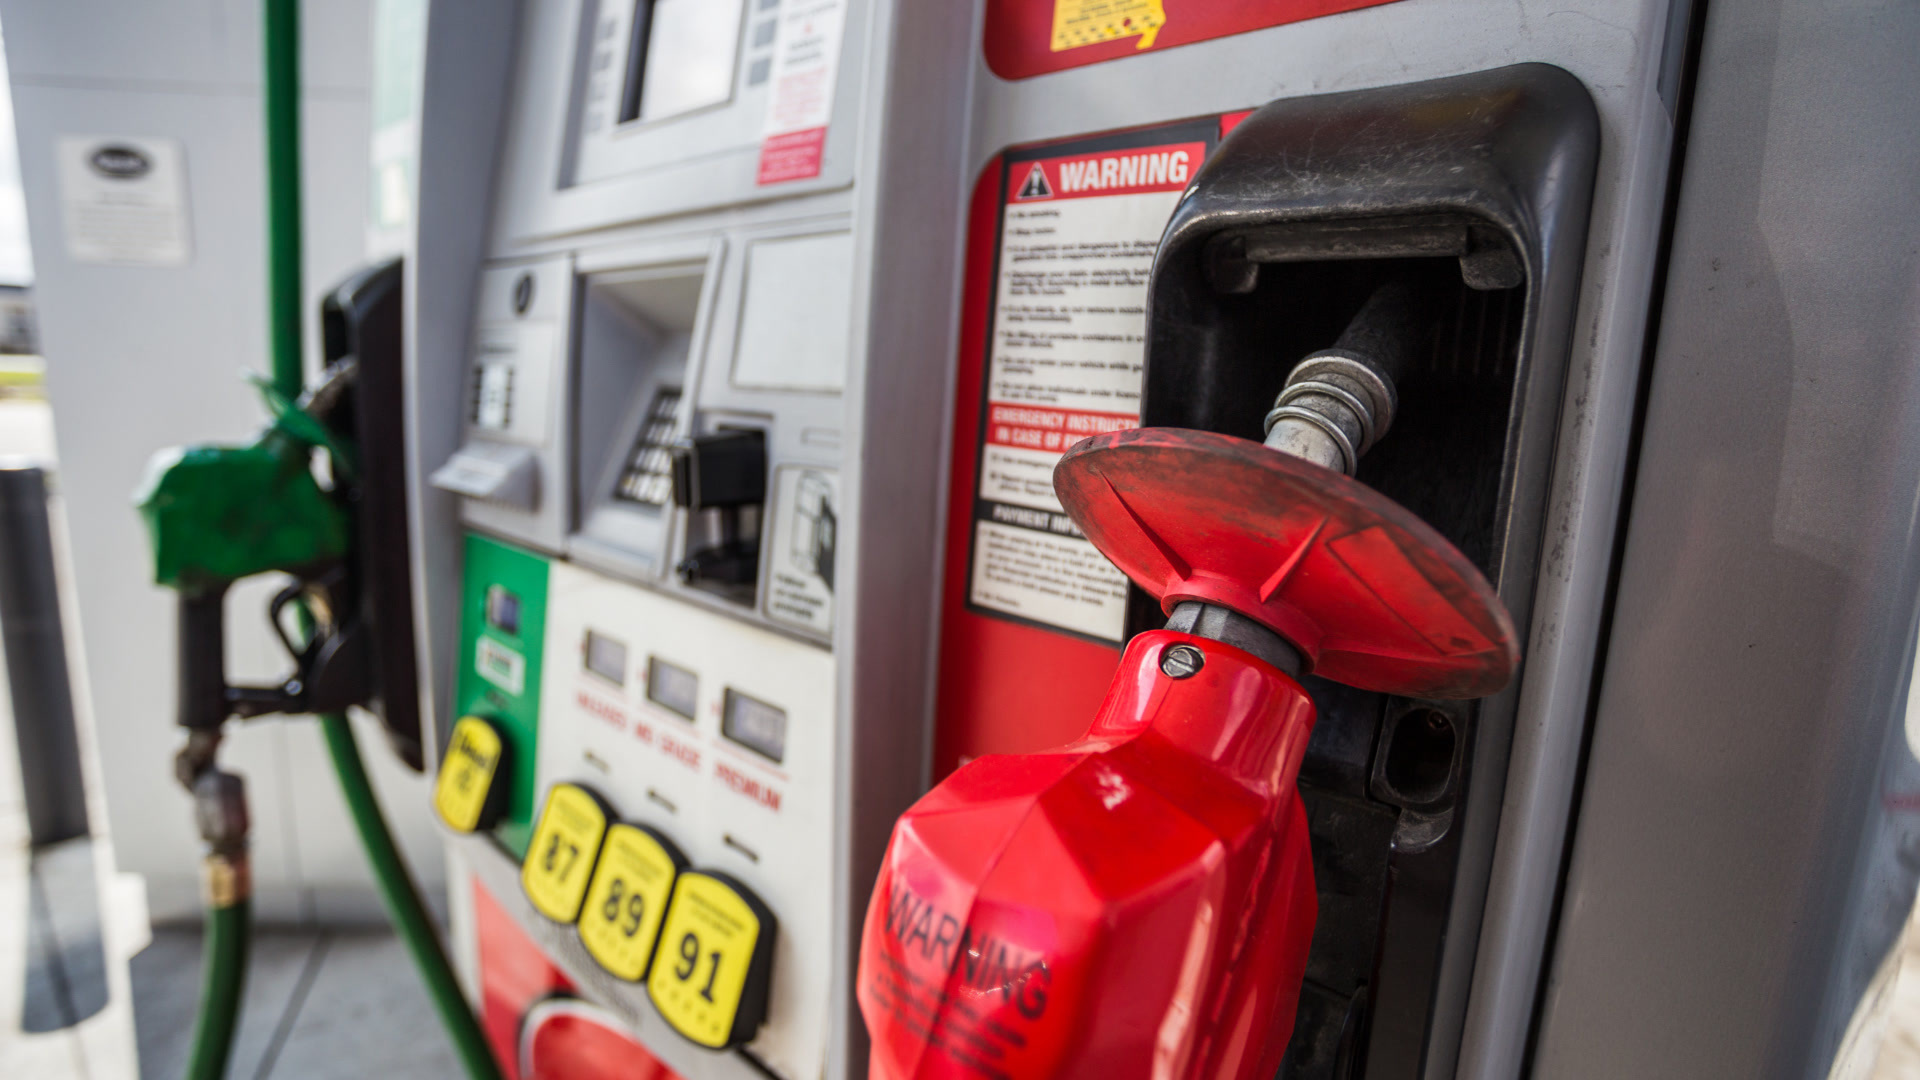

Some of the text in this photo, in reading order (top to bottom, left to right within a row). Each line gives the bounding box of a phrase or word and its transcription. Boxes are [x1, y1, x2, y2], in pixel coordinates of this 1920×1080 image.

[1059, 151, 1189, 193] WARNING
[992, 405, 1066, 430] EMERGENCY
[1011, 427, 1043, 446] CASE
[992, 505, 1050, 530] PAYMENT
[714, 761, 783, 814] PREMIUM
[542, 832, 580, 884] 87
[602, 876, 646, 939] 89
[673, 931, 723, 1004] 91
[885, 884, 1052, 1021] WARNING
